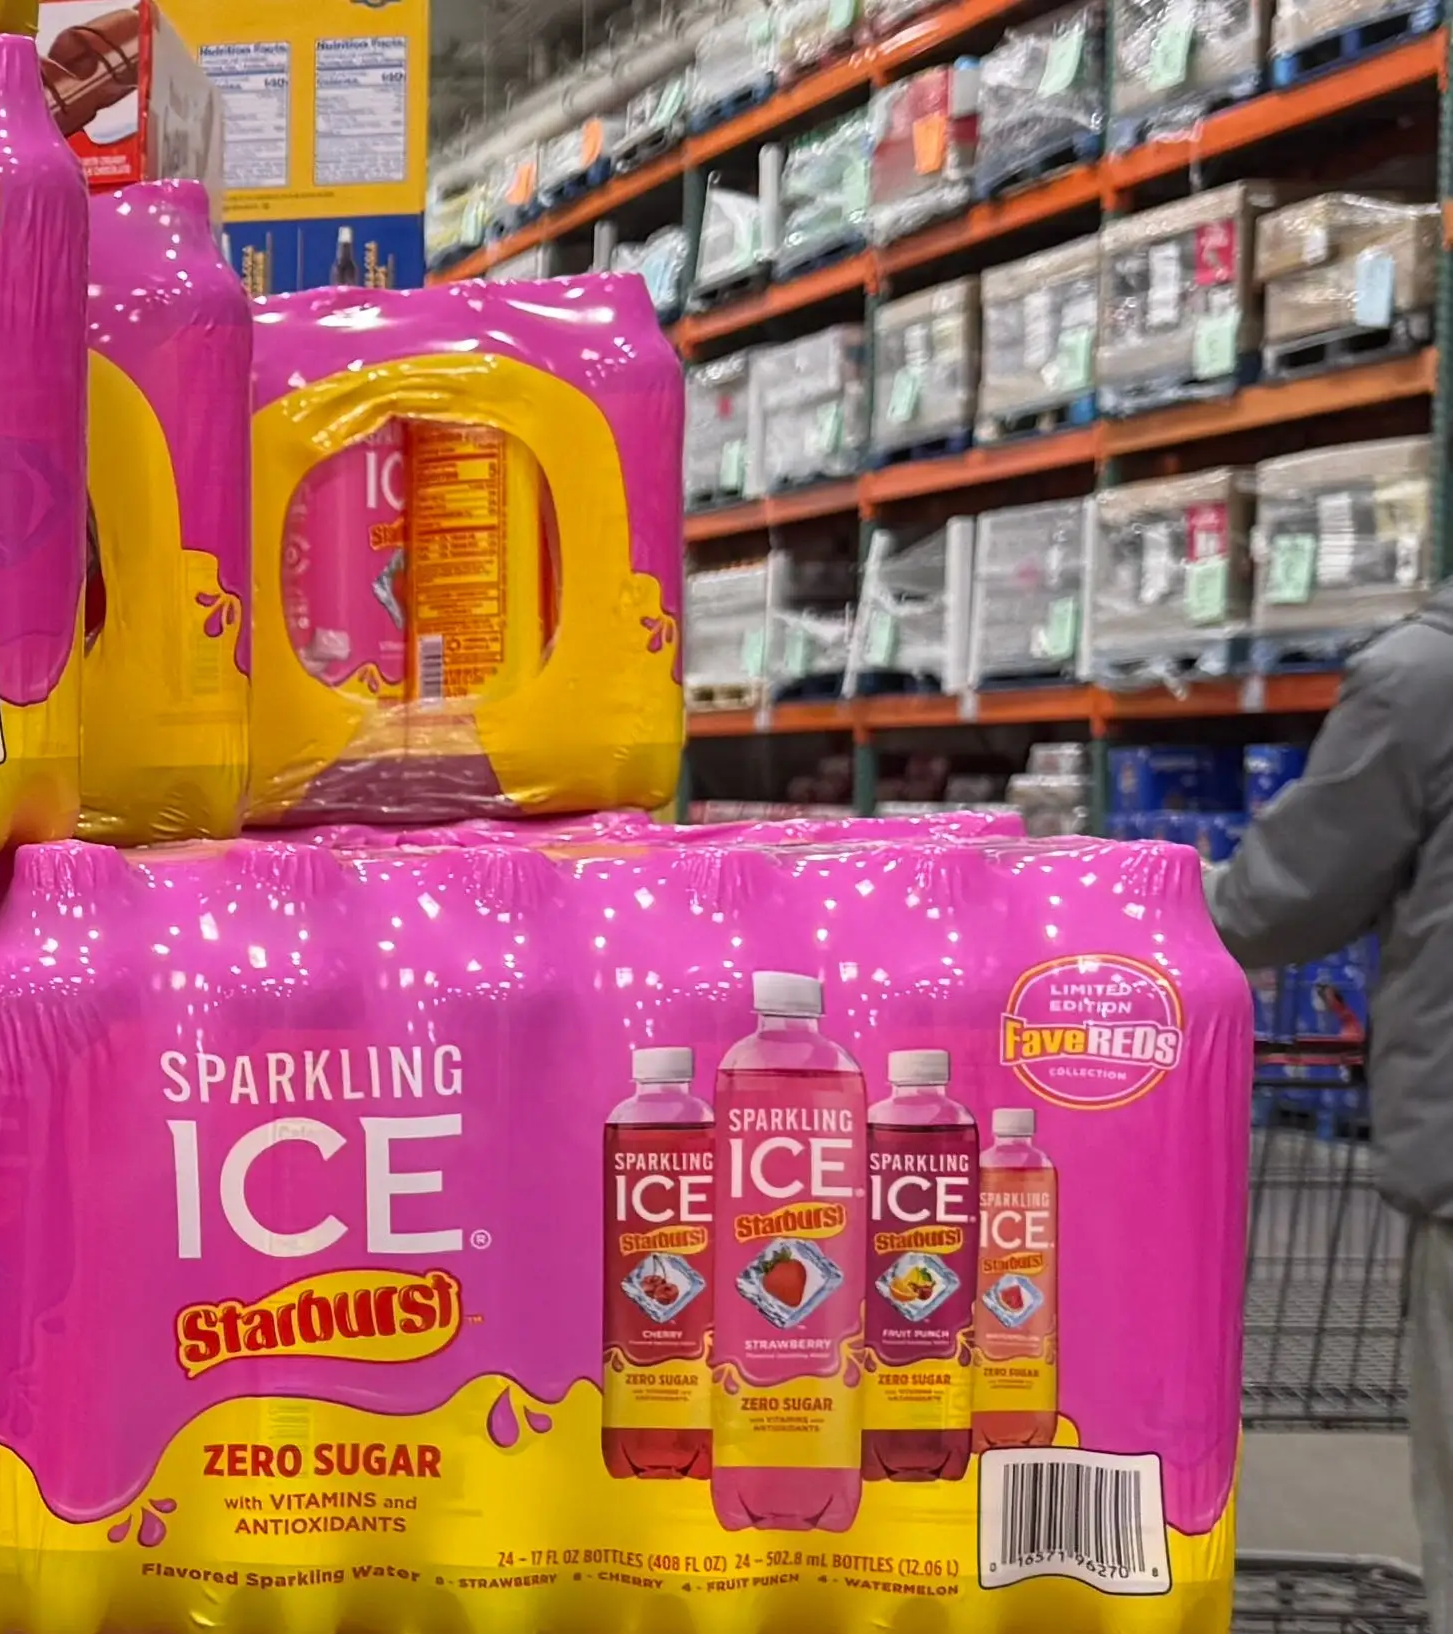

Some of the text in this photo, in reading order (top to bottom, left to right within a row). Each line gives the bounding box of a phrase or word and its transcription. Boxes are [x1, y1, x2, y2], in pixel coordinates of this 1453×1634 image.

[1050, 984, 1133, 997] LIMITED
[1049, 1000, 1133, 1015] EDITION
[161, 1032, 461, 1104] SPARKLING
[1048, 1068, 1128, 1081] COLLECTION
[728, 1109, 852, 1132] SPARKLING
[616, 1152, 711, 1171] SPARKLING
[872, 1154, 968, 1172] SPARKLING
[978, 1191, 1050, 1208] SPARKLING
[736, 1204, 844, 1238] Starburst
[621, 1228, 705, 1254] Starburst
[876, 1229, 961, 1252] Starburst
[983, 1254, 1043, 1274] Starburst
[184, 1272, 457, 1366] Starburst
[745, 1338, 831, 1351] STRAWBERRY
[741, 1397, 832, 1412] ZERO SUGAR
[204, 1444, 440, 1477] ZERO SUGAR
[228, 1492, 416, 1511] with VITAMINS and
[235, 1516, 406, 1535] ANTIOXIDANTS
